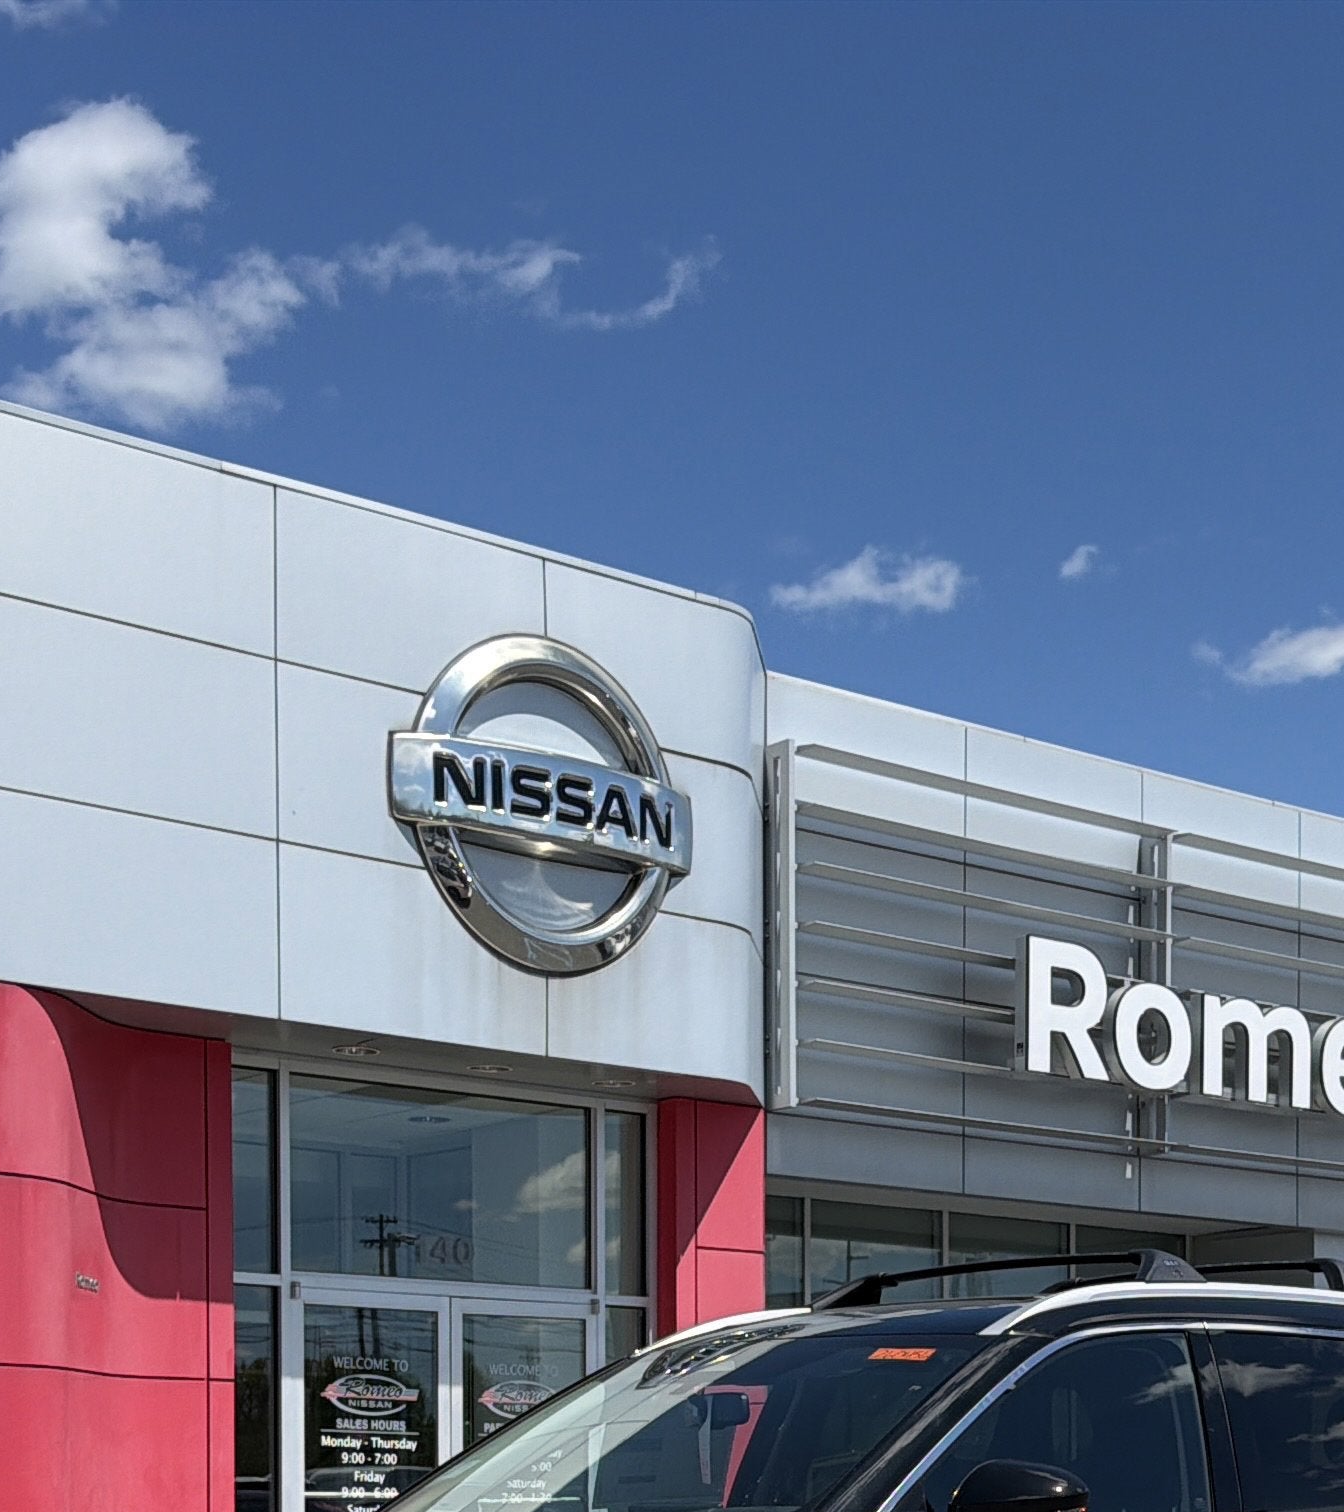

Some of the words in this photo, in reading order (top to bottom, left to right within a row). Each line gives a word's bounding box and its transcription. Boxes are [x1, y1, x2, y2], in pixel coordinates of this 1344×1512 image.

[432, 750, 675, 852] NISSAN
[333, 1355, 390, 1371] WELCOME
[393, 1359, 409, 1372] TO
[488, 1363, 540, 1377] WELCOME
[338, 1377, 403, 1398] Romeo
[347, 1399, 392, 1409] NISSAN
[336, 1418, 368, 1430] SALES
[371, 1420, 406, 1433] HOURS
[320, 1435, 362, 1450] Monday
[370, 1437, 417, 1452] Thursday
[341, 1452, 365, 1464] 9:00
[374, 1453, 398, 1465] 7:00
[354, 1470, 385, 1484] Friday
